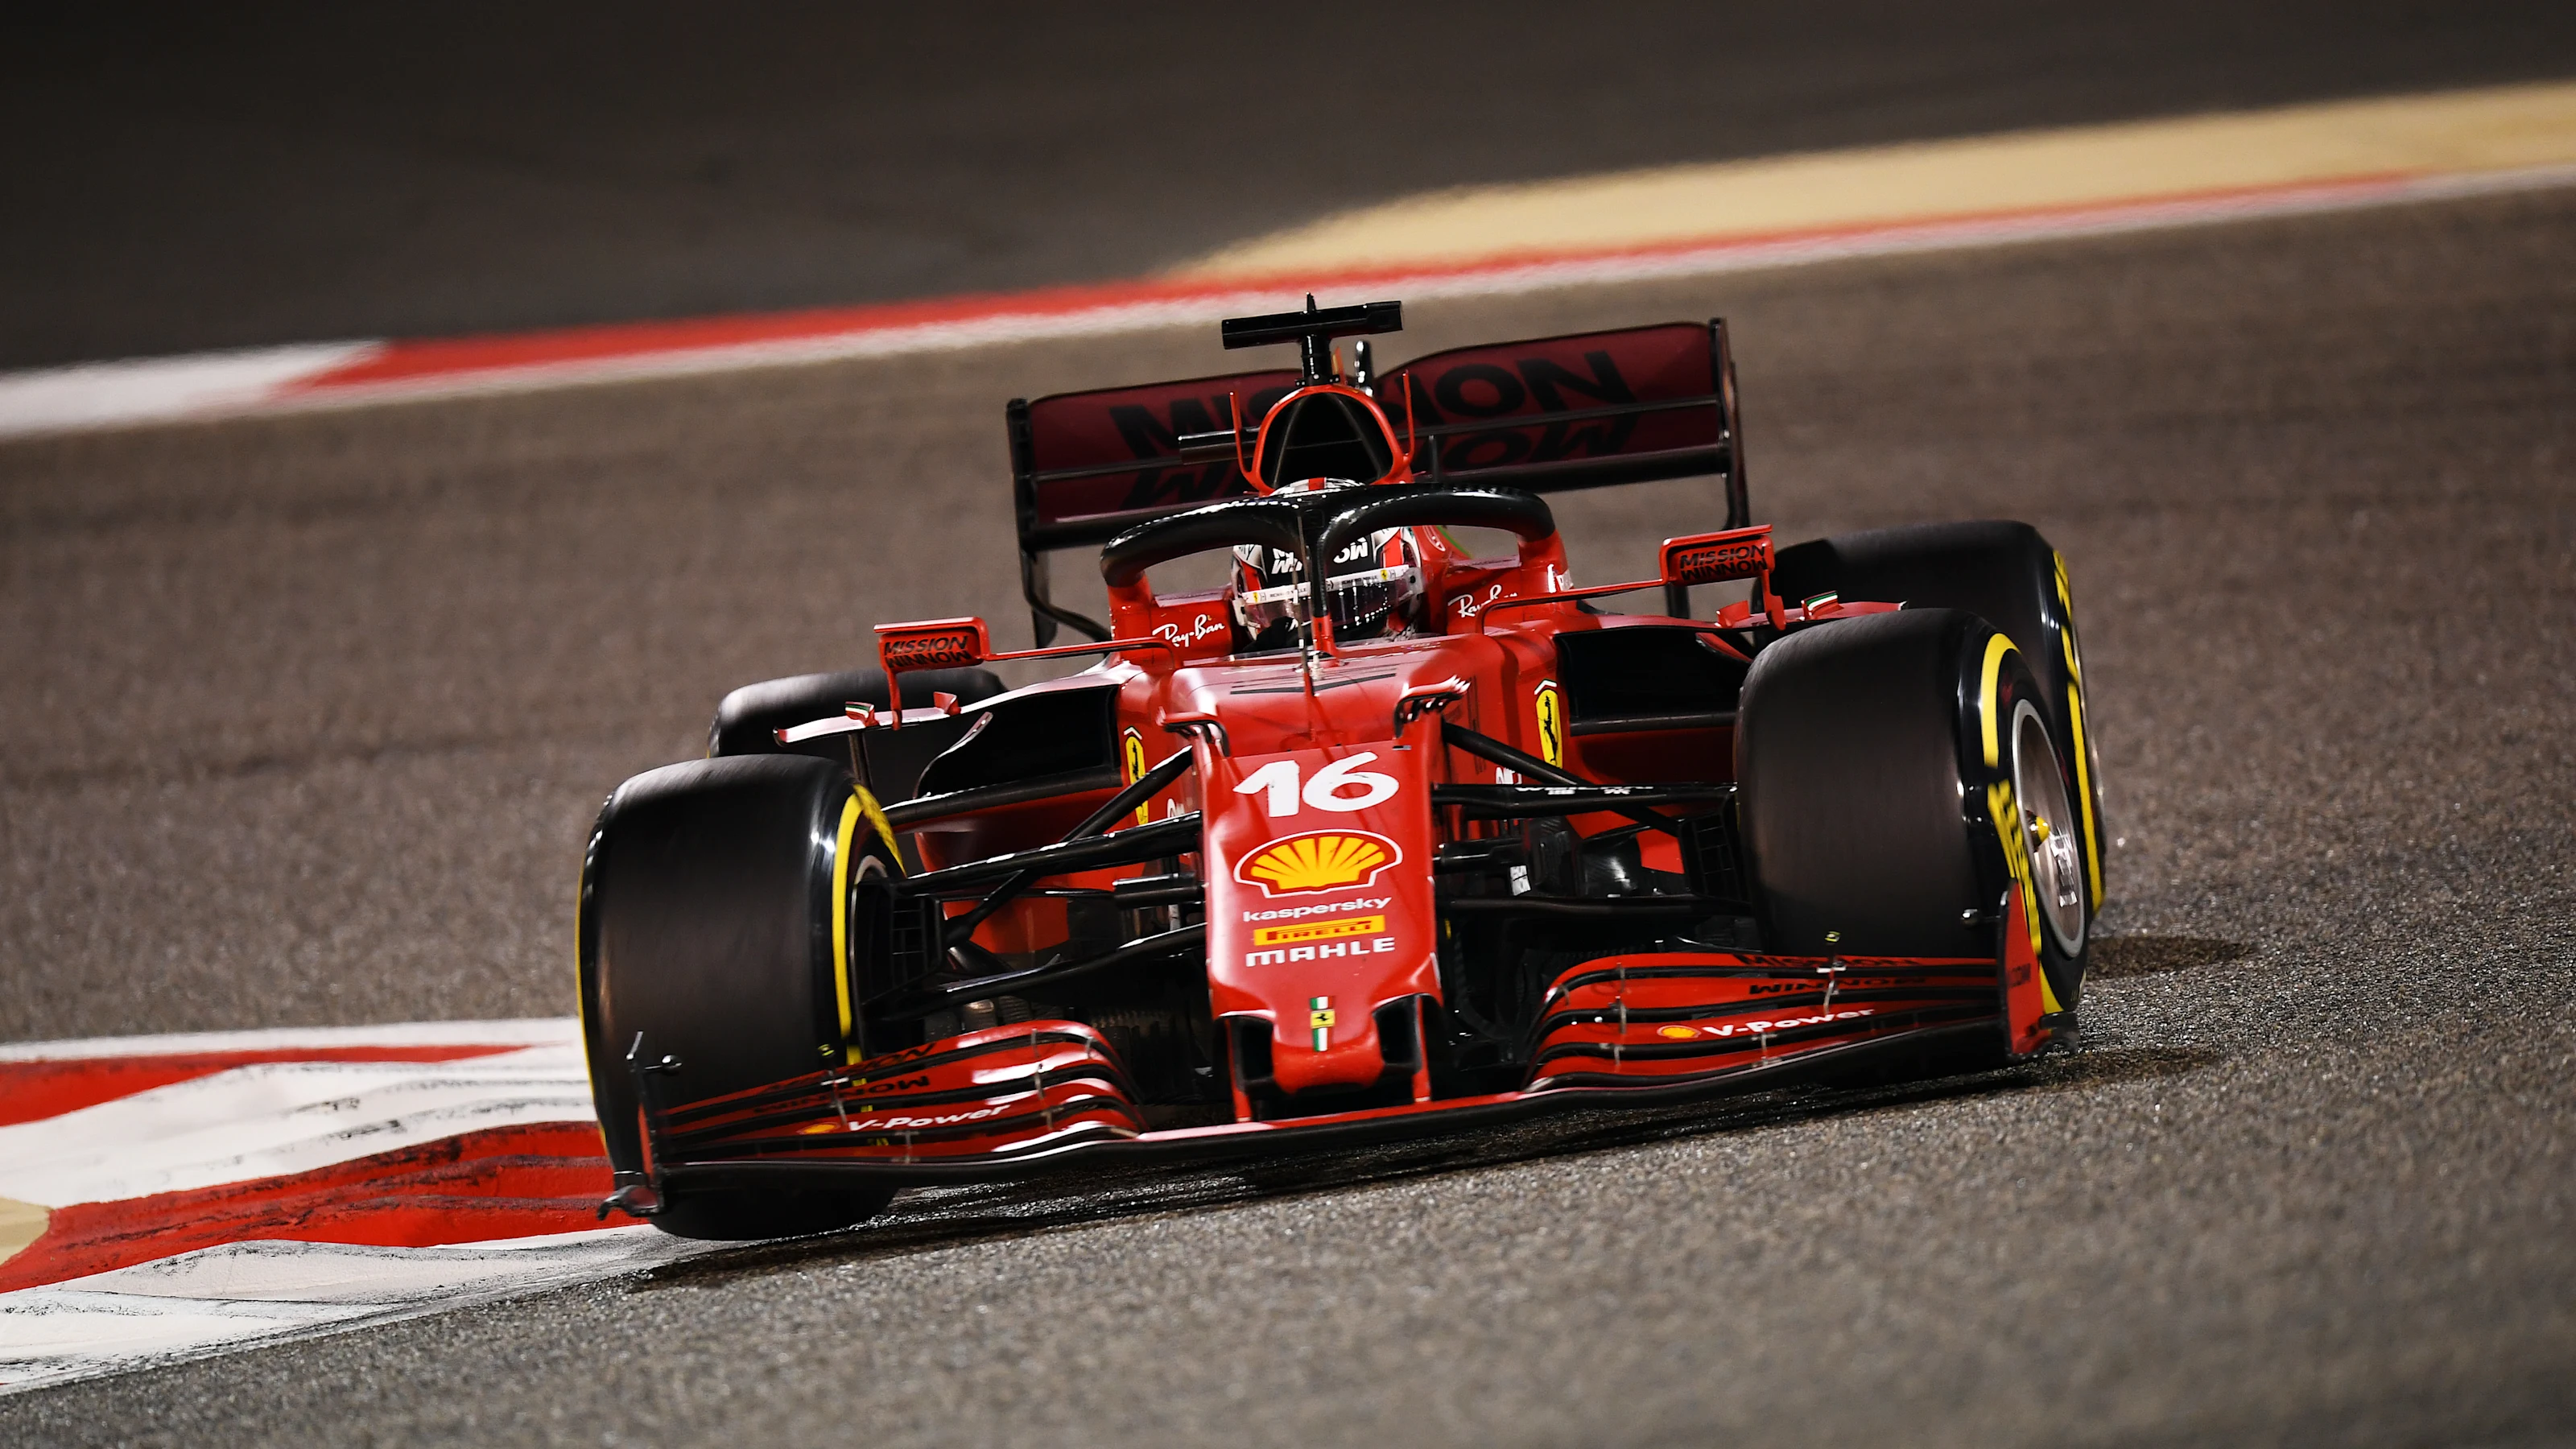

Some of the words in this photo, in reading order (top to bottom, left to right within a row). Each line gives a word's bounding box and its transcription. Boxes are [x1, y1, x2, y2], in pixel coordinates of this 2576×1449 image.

[1680, 545, 1765, 569] MISSION
[1680, 558, 1768, 581] WINNOW
[1152, 613, 1225, 647] Ray-Ban
[885, 635, 968, 656] MISSION
[885, 650, 972, 669] WINNOW
[1232, 751, 1400, 818] 16
[1243, 897, 1392, 923] kaspersky
[1265, 920, 1373, 941] PIRELLI
[1245, 937, 1396, 968] MAHLE
[1703, 1008, 1875, 1036] V-Power
[848, 1104, 1011, 1132] V-Power
